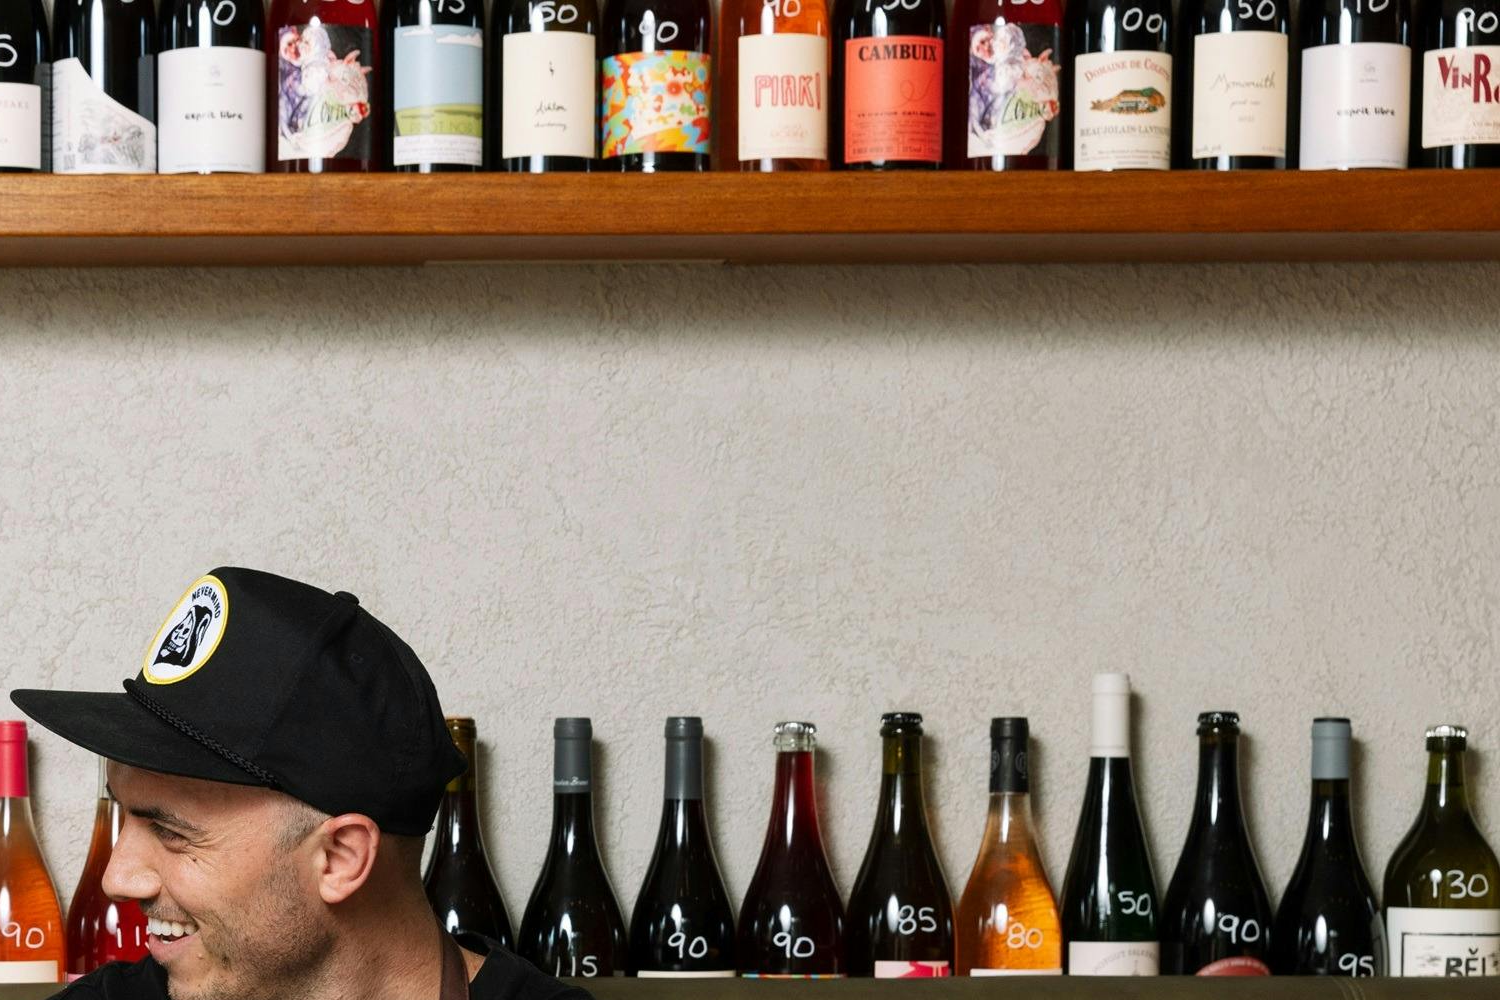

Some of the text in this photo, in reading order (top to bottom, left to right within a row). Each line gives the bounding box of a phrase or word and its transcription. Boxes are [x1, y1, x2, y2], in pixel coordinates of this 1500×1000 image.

[186, 0, 237, 28] 10
[1112, 6, 1163, 34] 00
[1224, 0, 1276, 21] 50
[1457, 7, 1499, 34] 90
[858, 44, 938, 63] CAMBUIX
[184, 110, 244, 122] esprit libre
[1373, 106, 1396, 117] libre
[191, 586, 221, 619] NEVERMIND
[1430, 869, 1489, 899] 130
[1106, 891, 1151, 916] 50
[899, 905, 937, 935] 85
[1218, 914, 1260, 944] 90
[1, 922, 44, 949] 90
[668, 932, 707, 959] 90
[773, 932, 815, 958] 90
[1007, 923, 1043, 949] 80
[556, 955, 598, 978] 115
[1338, 953, 1375, 978] 95
